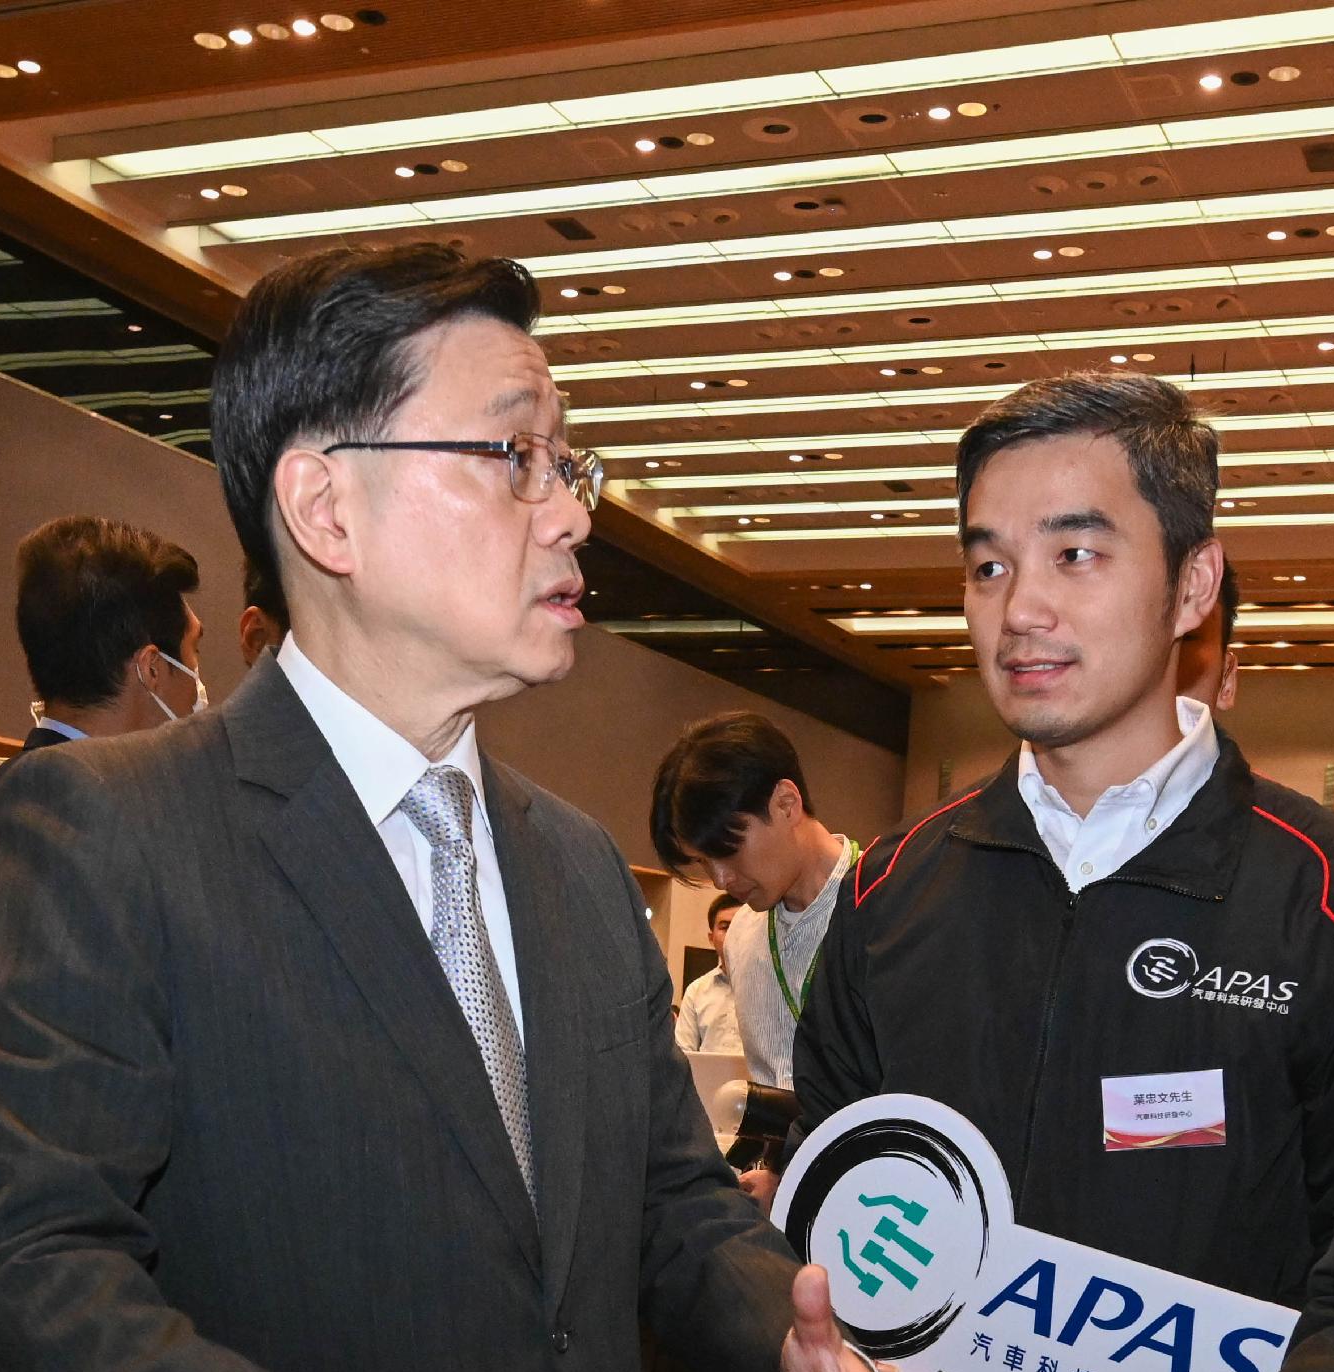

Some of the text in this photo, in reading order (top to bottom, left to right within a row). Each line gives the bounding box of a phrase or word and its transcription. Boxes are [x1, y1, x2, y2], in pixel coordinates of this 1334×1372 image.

[1194, 966, 1299, 1001] APAS
[1190, 987, 1289, 1015] 汽車科技研發中心
[1132, 1090, 1194, 1106] 葉忠文先生
